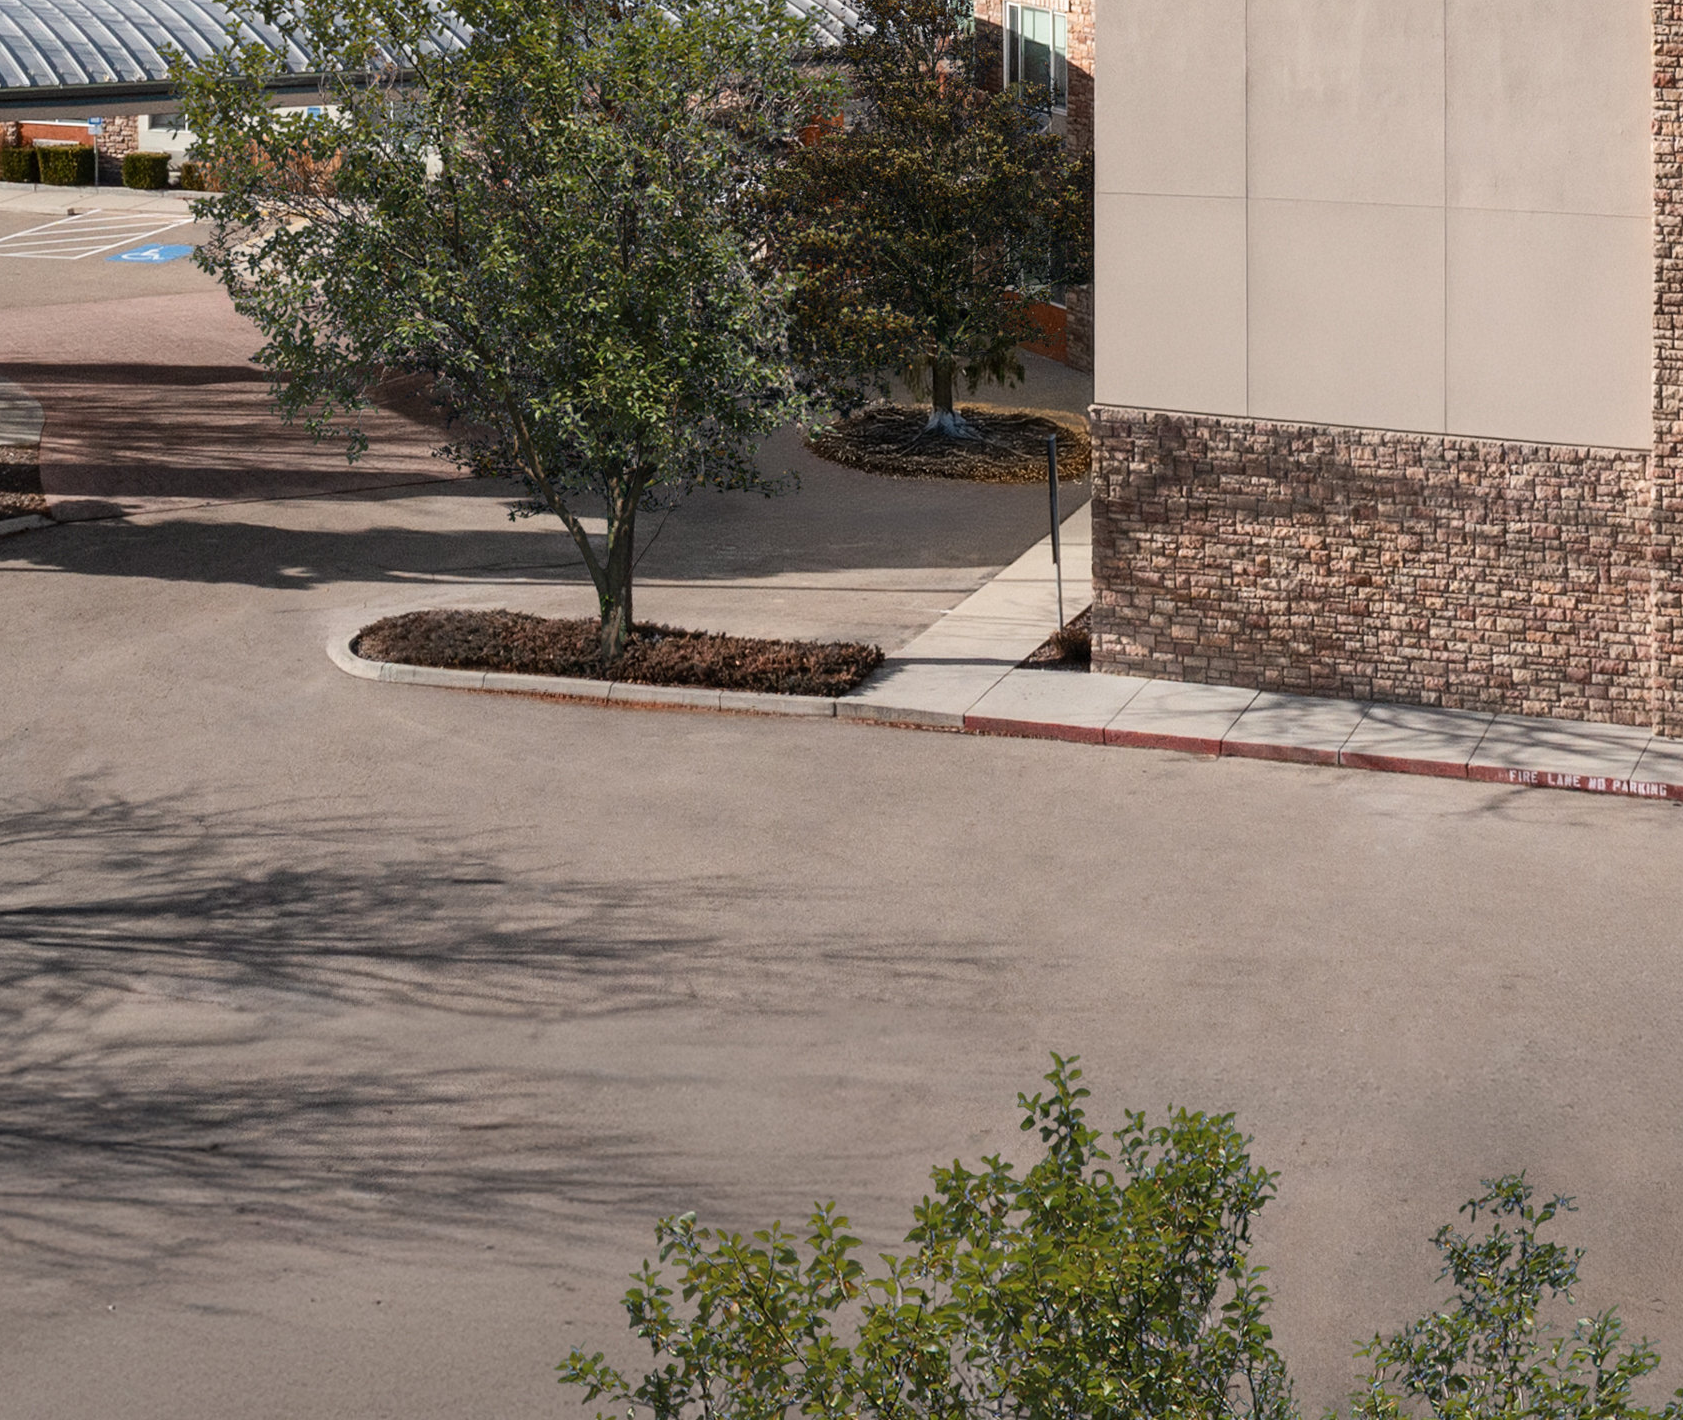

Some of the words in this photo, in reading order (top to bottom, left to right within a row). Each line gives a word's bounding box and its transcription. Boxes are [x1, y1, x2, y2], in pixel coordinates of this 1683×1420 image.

[1509, 769, 1538, 783] FIRE
[1547, 773, 1581, 788] LANE
[1588, 777, 1605, 791] NO
[1612, 779, 1667, 796] PARKING
